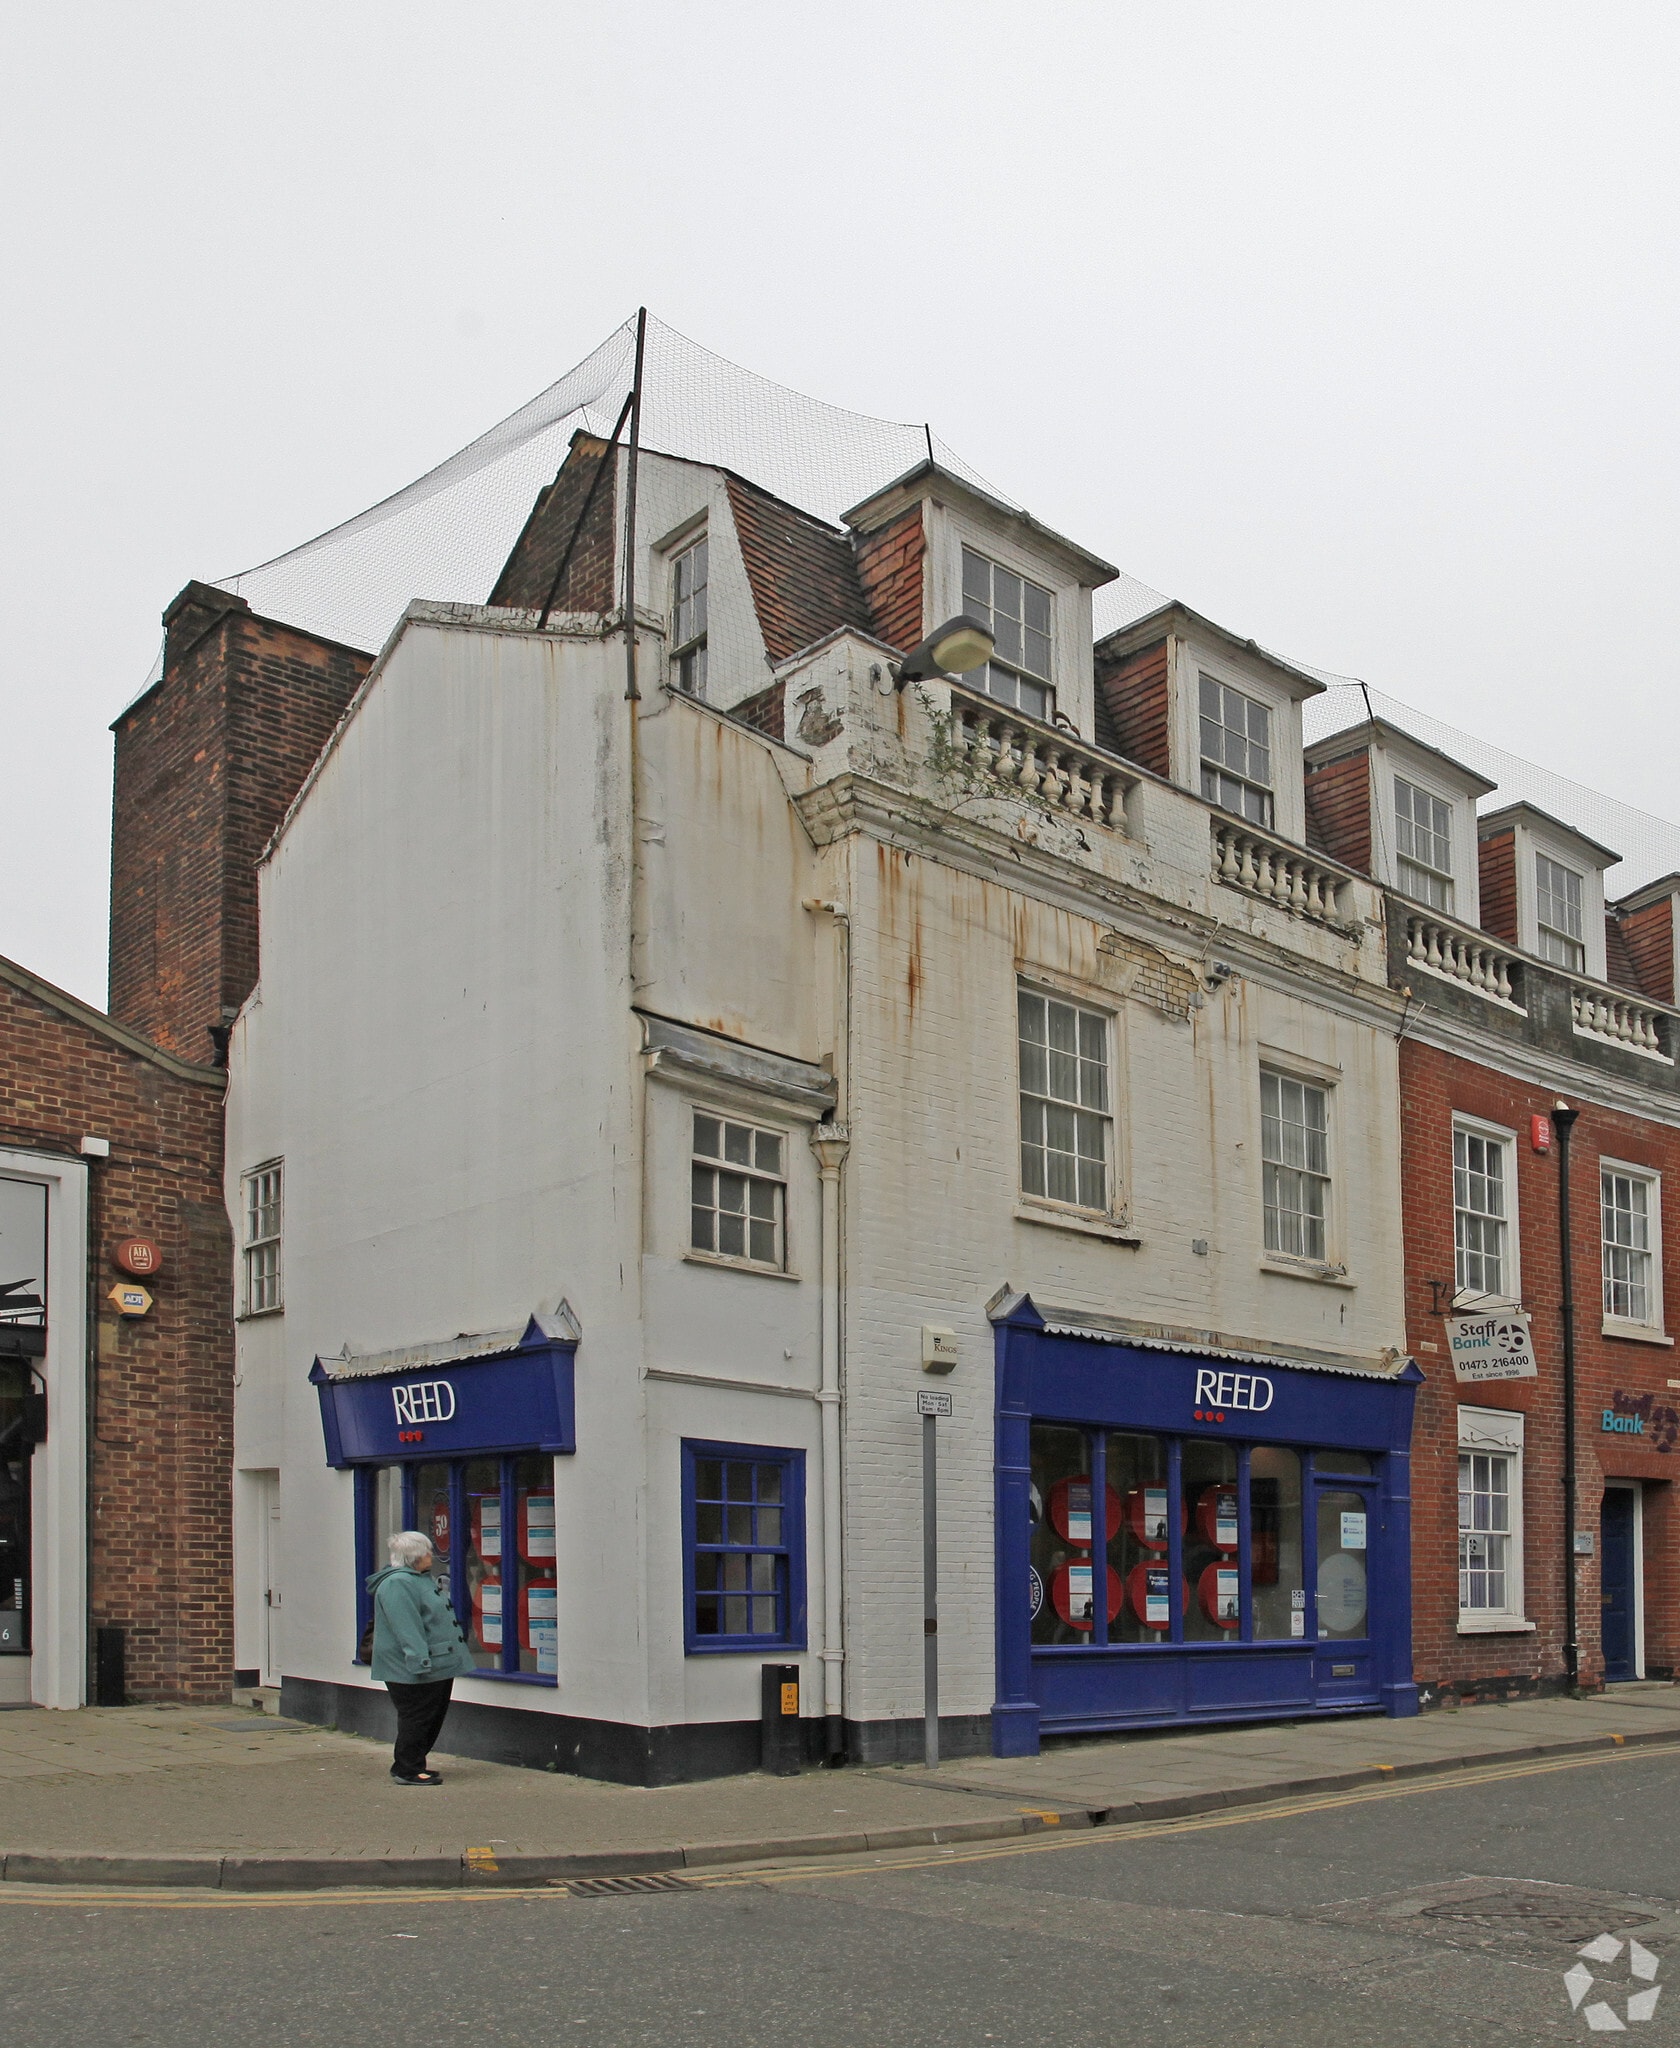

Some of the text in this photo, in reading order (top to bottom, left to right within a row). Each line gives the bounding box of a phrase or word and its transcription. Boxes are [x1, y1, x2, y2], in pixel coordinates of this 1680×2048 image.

[133, 1246, 148, 1257] AFA
[124, 1294, 144, 1304] ADT
[1460, 1320, 1497, 1337] Staff
[1452, 1335, 1491, 1350] Bank
[1459, 1355, 1529, 1371] 01473 216400
[929, 1394, 949, 1402] loading
[1194, 1368, 1274, 1412] REED
[391, 1380, 456, 1425] REED
[1601, 1409, 1645, 1435] Bank
[435, 1514, 448, 1537] 50
[1030, 1581, 1040, 1610] PEOPLE
[2, 1628, 10, 1640] 6
